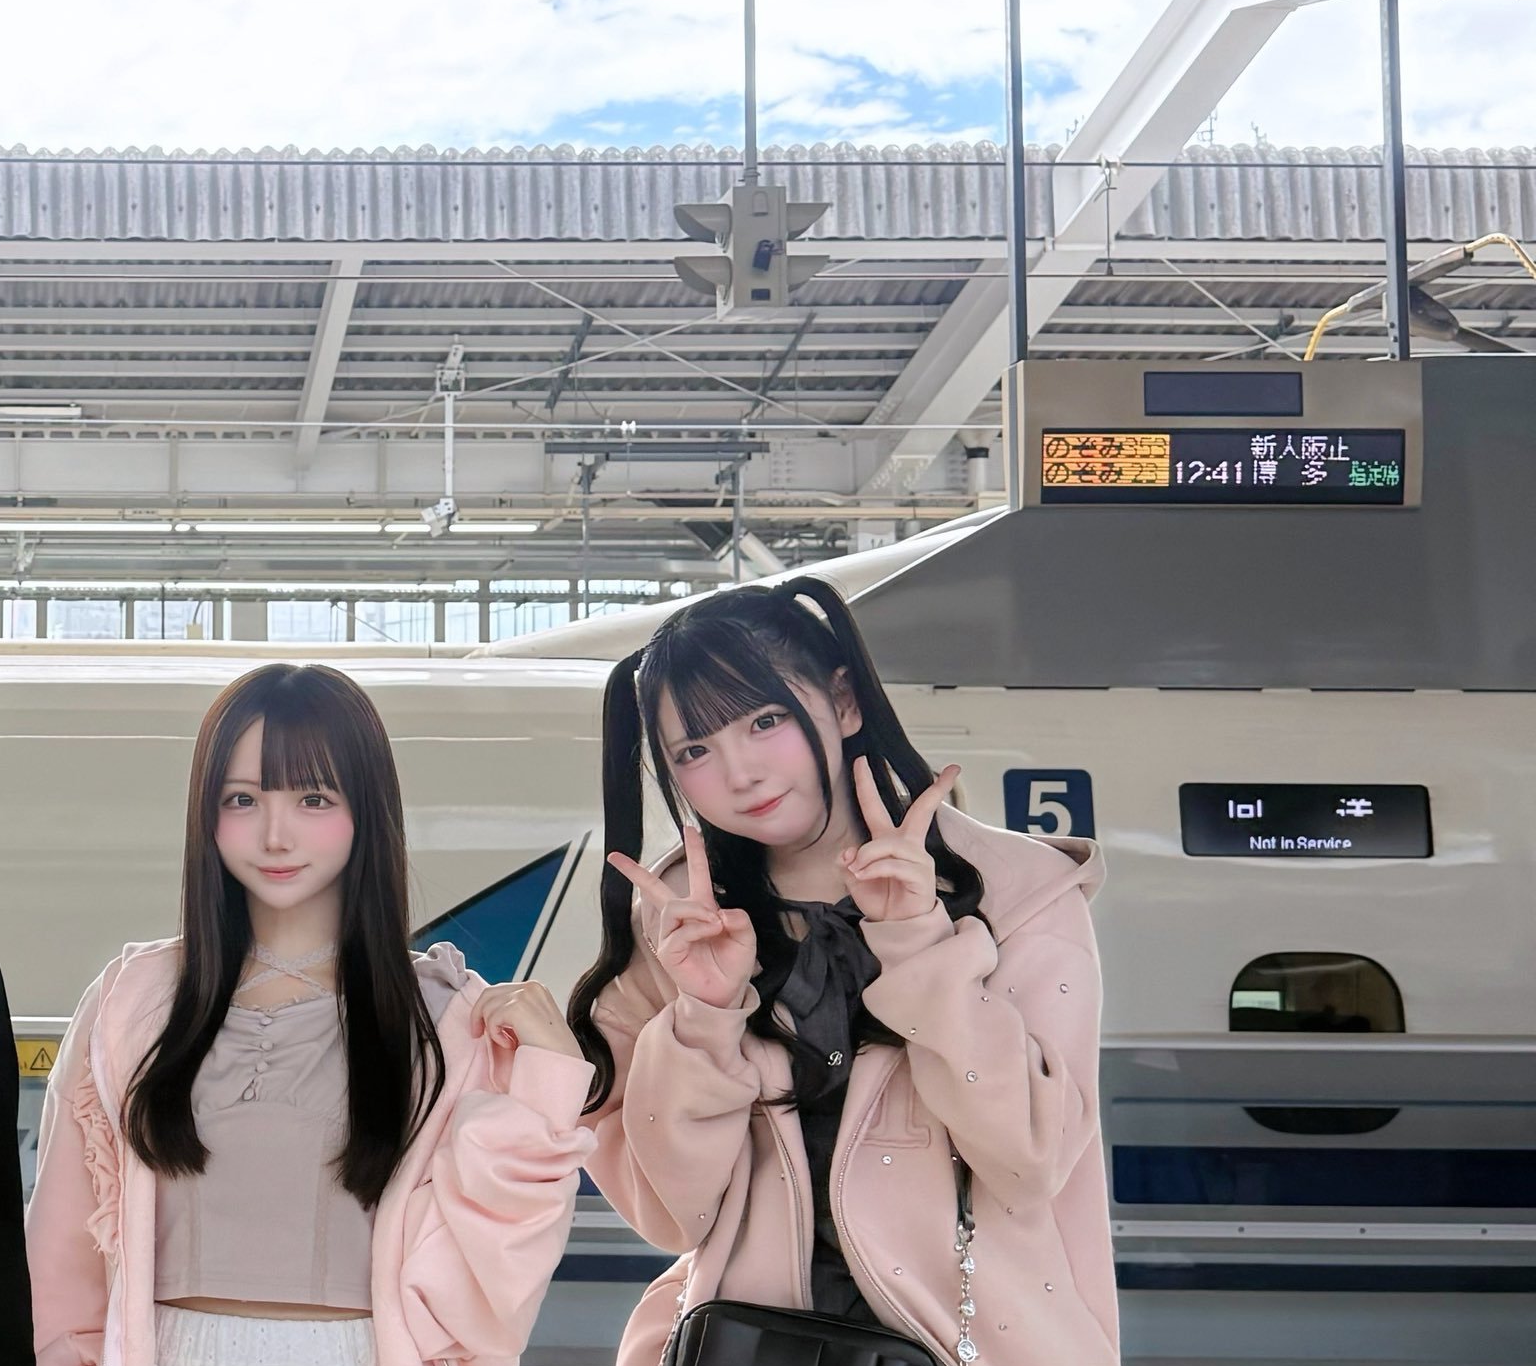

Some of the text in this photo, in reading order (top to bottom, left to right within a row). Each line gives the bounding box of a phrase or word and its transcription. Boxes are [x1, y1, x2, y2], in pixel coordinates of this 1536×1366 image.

[1175, 461, 1243, 484] 12:41
[1027, 780, 1072, 837] 5
[1249, 835, 1277, 851] Not
[1296, 835, 1353, 850] Service
